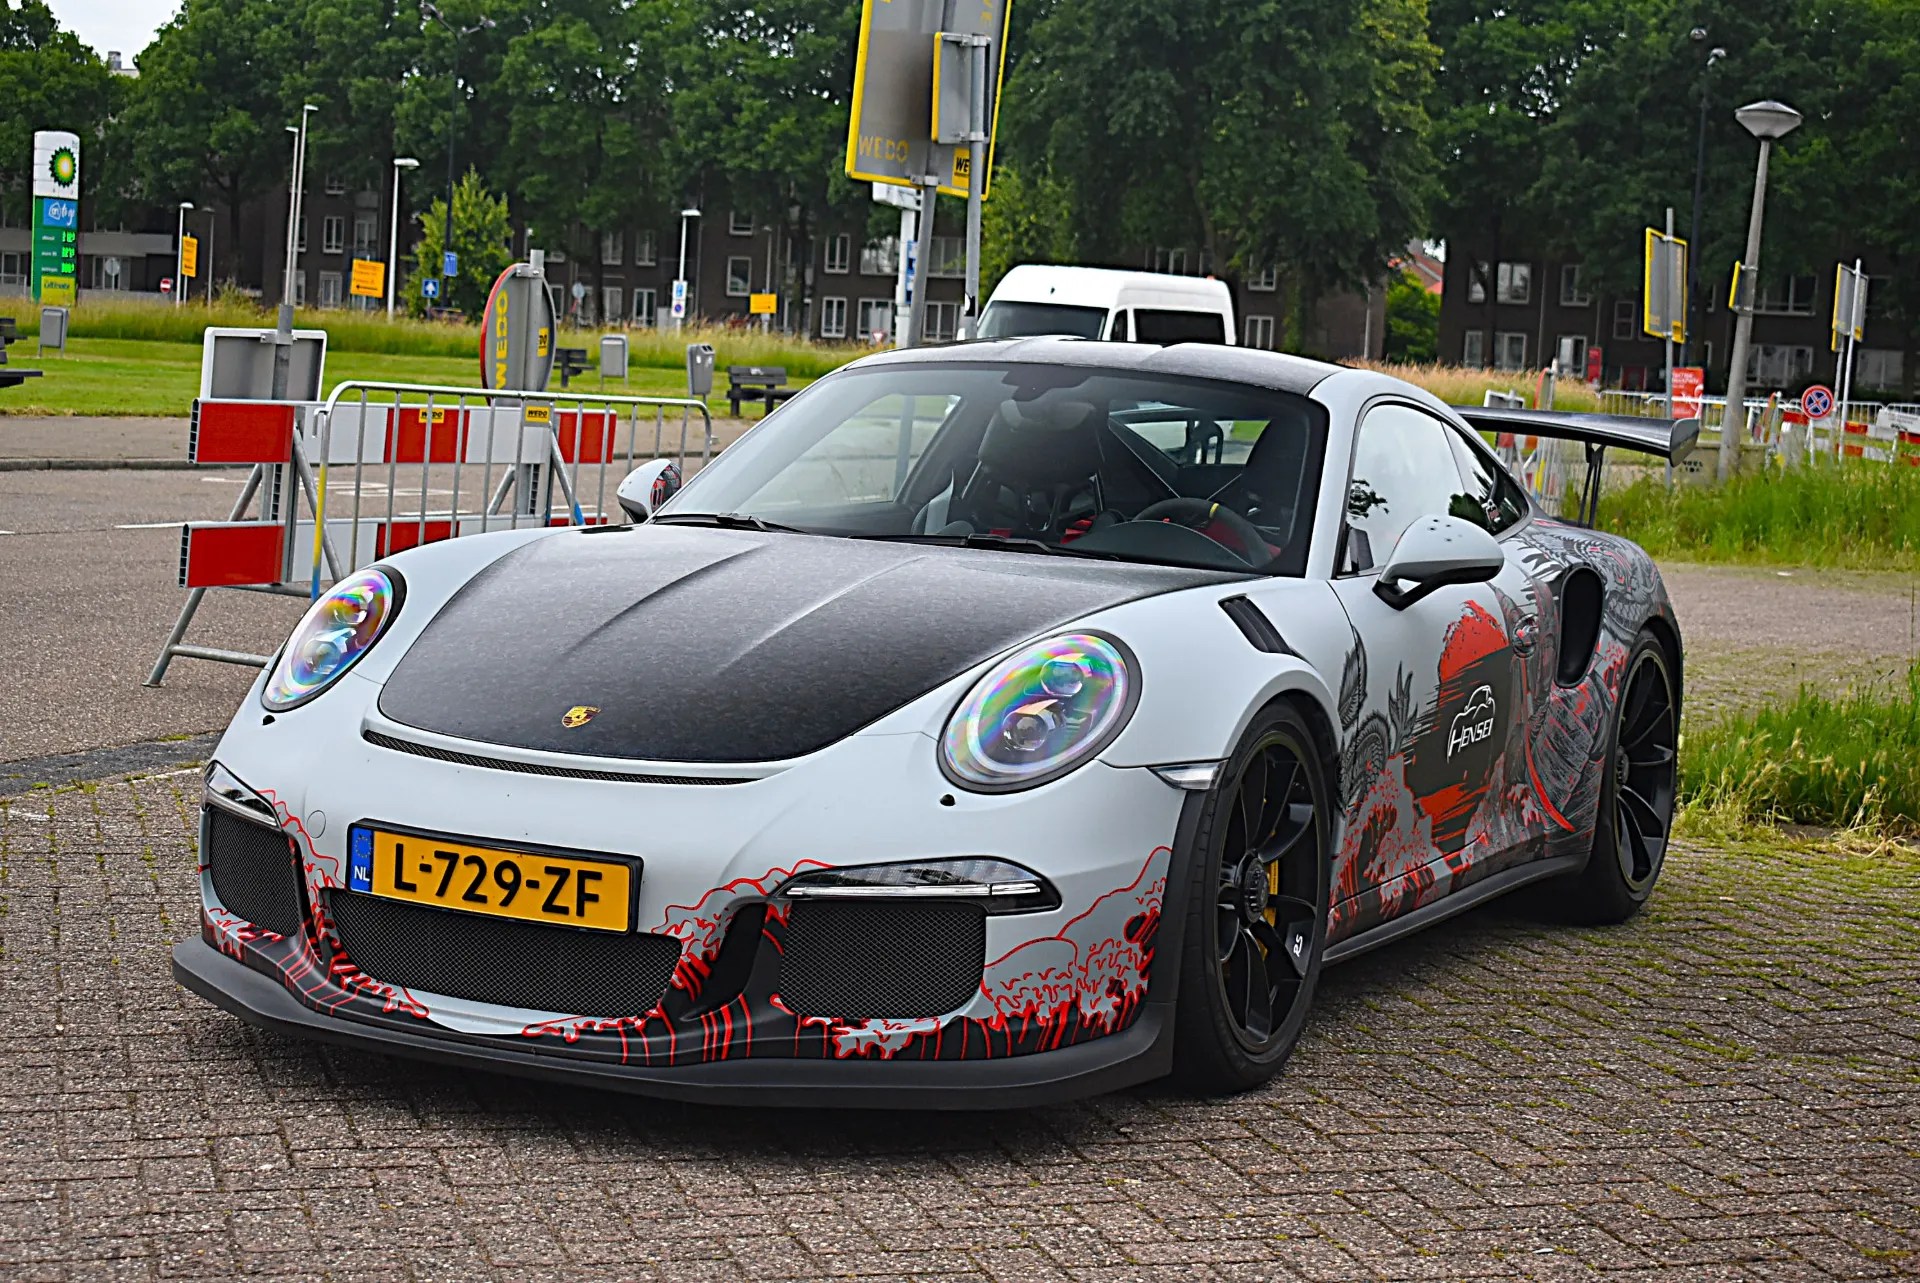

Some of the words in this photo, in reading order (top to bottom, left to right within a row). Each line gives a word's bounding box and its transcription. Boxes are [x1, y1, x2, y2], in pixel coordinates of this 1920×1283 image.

[857, 135, 909, 163] WEDO
[495, 289, 509, 389] WEDO
[528, 410, 548, 418] WEDO
[354, 865, 371, 882] NL
[393, 843, 603, 918] L-729-ZF
[1293, 933, 1303, 957] RS
